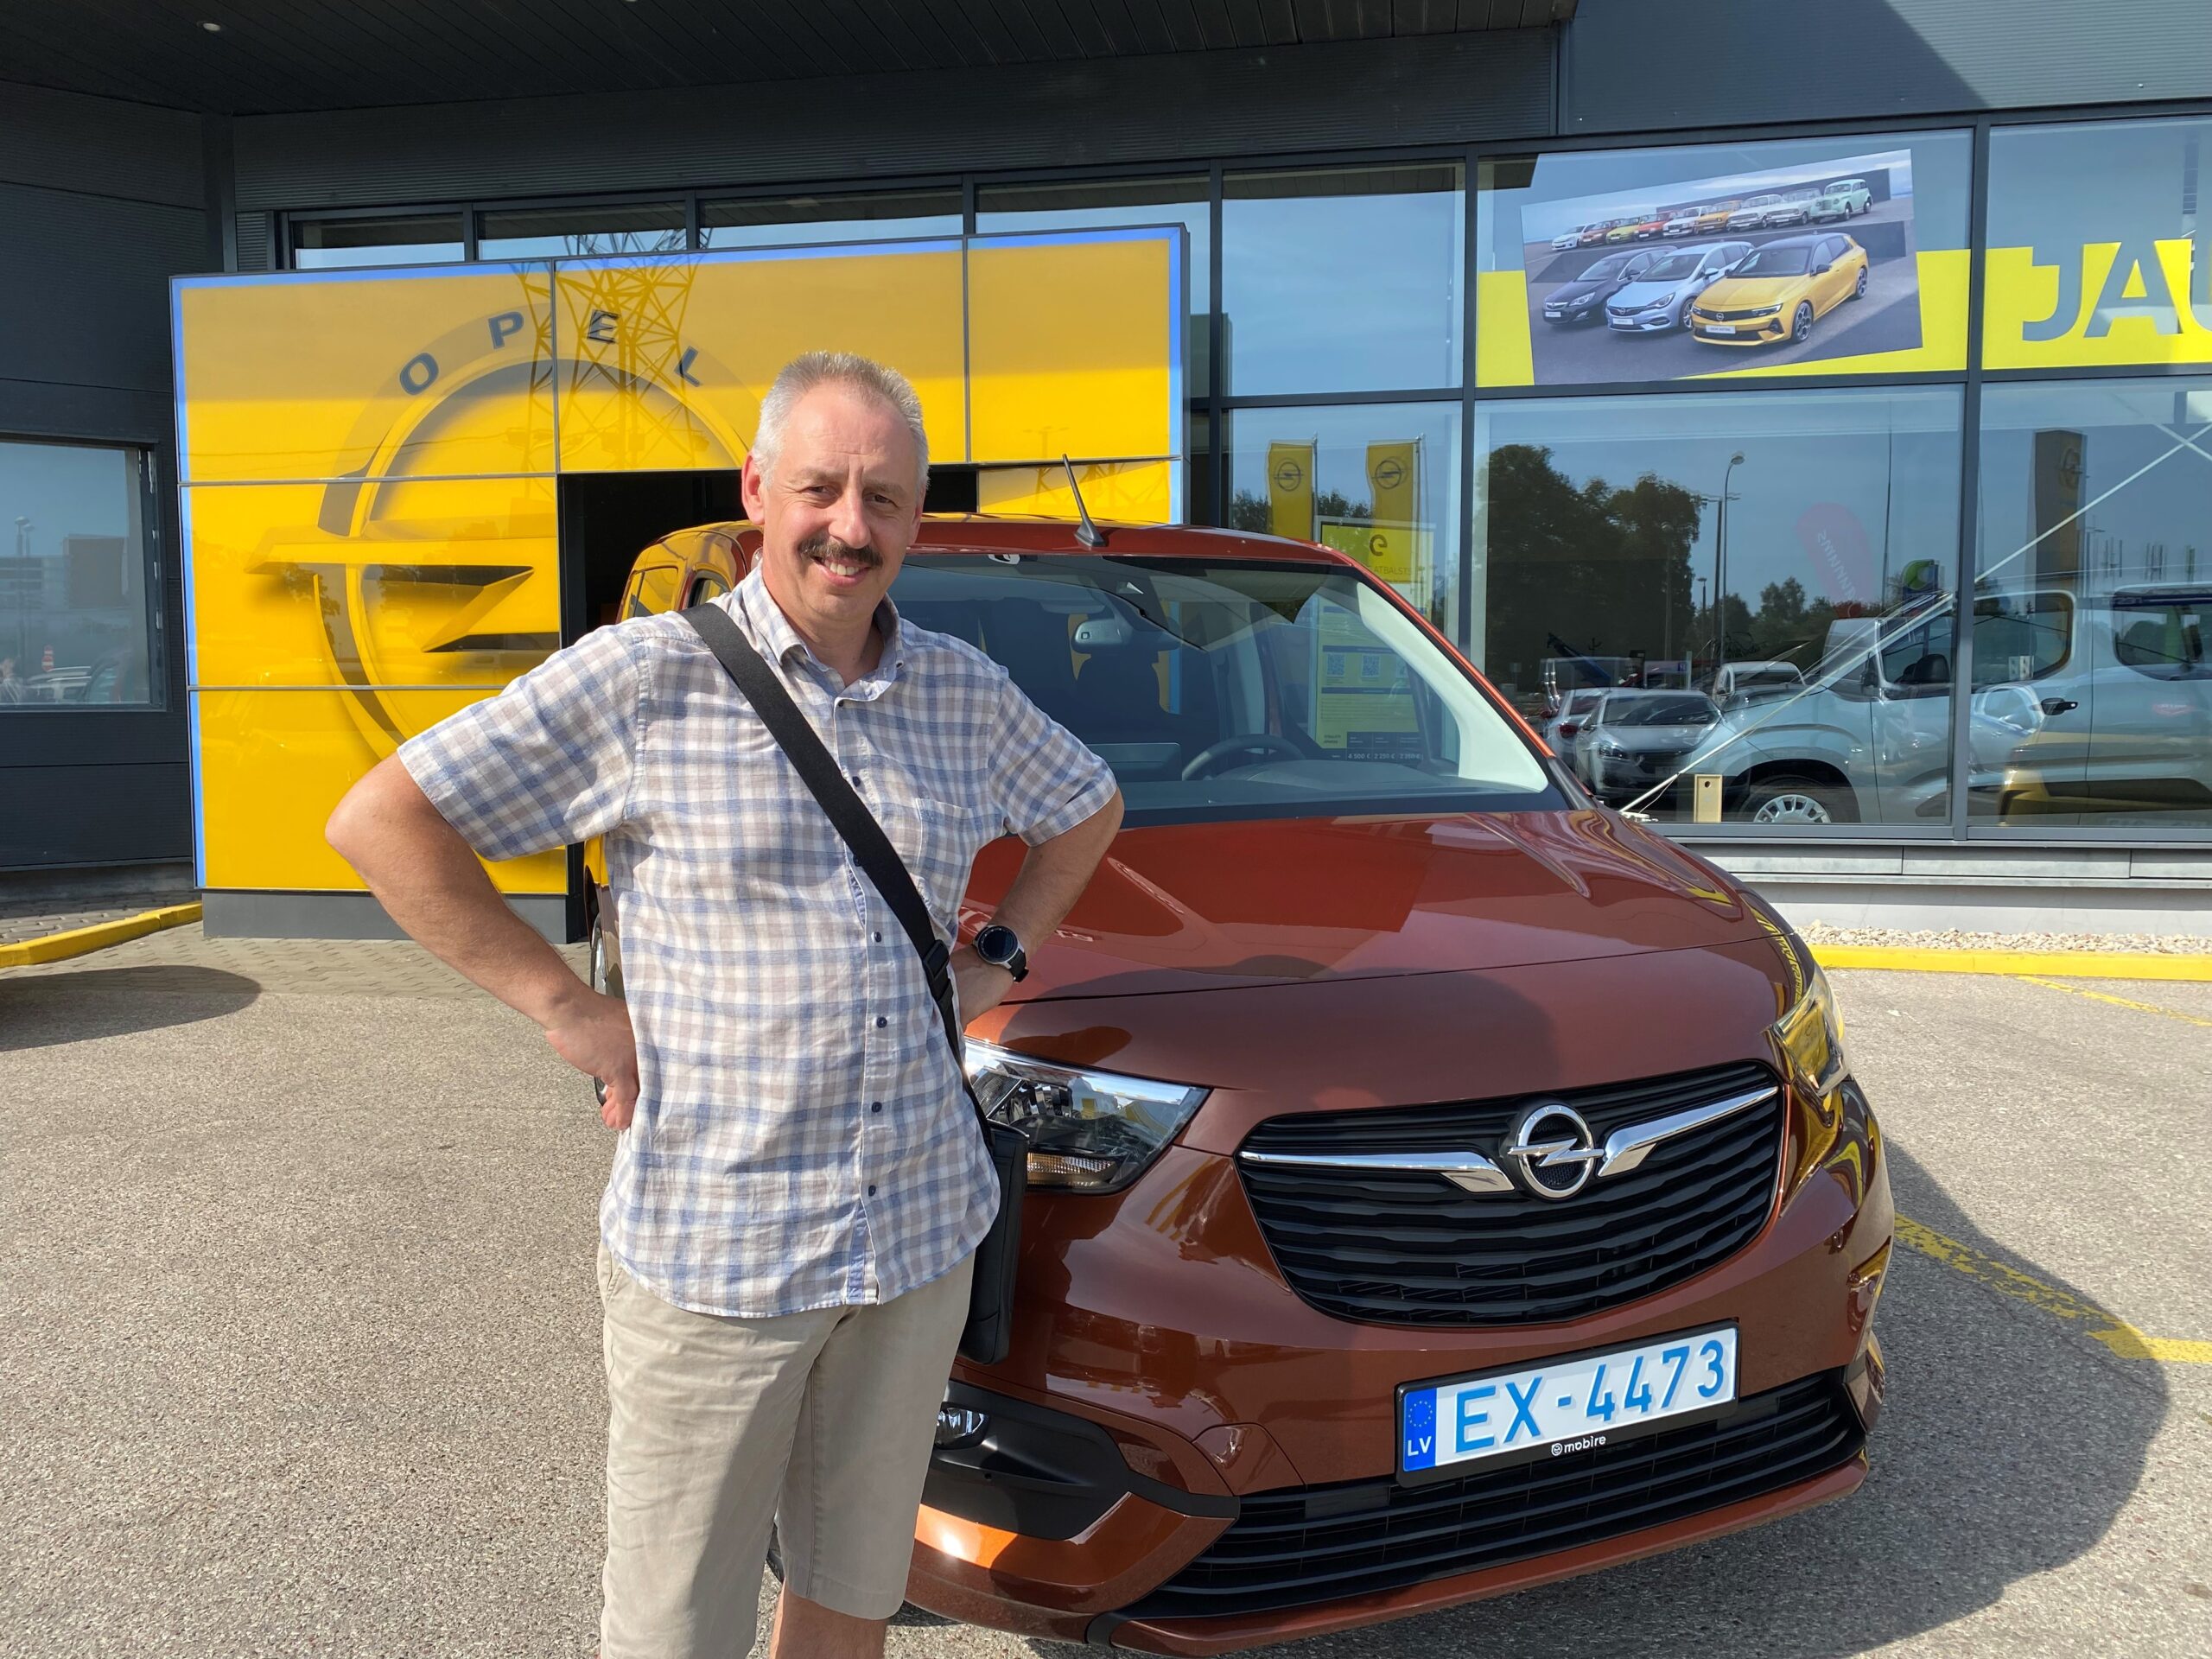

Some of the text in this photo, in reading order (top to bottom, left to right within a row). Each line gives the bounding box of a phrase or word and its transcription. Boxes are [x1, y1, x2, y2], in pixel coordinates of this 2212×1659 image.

[398, 309, 703, 395] OPEL
[1455, 1339, 1724, 1453] EX-4473
[1408, 1435, 1432, 1457] LV
[1564, 1435, 1606, 1453] mobire
